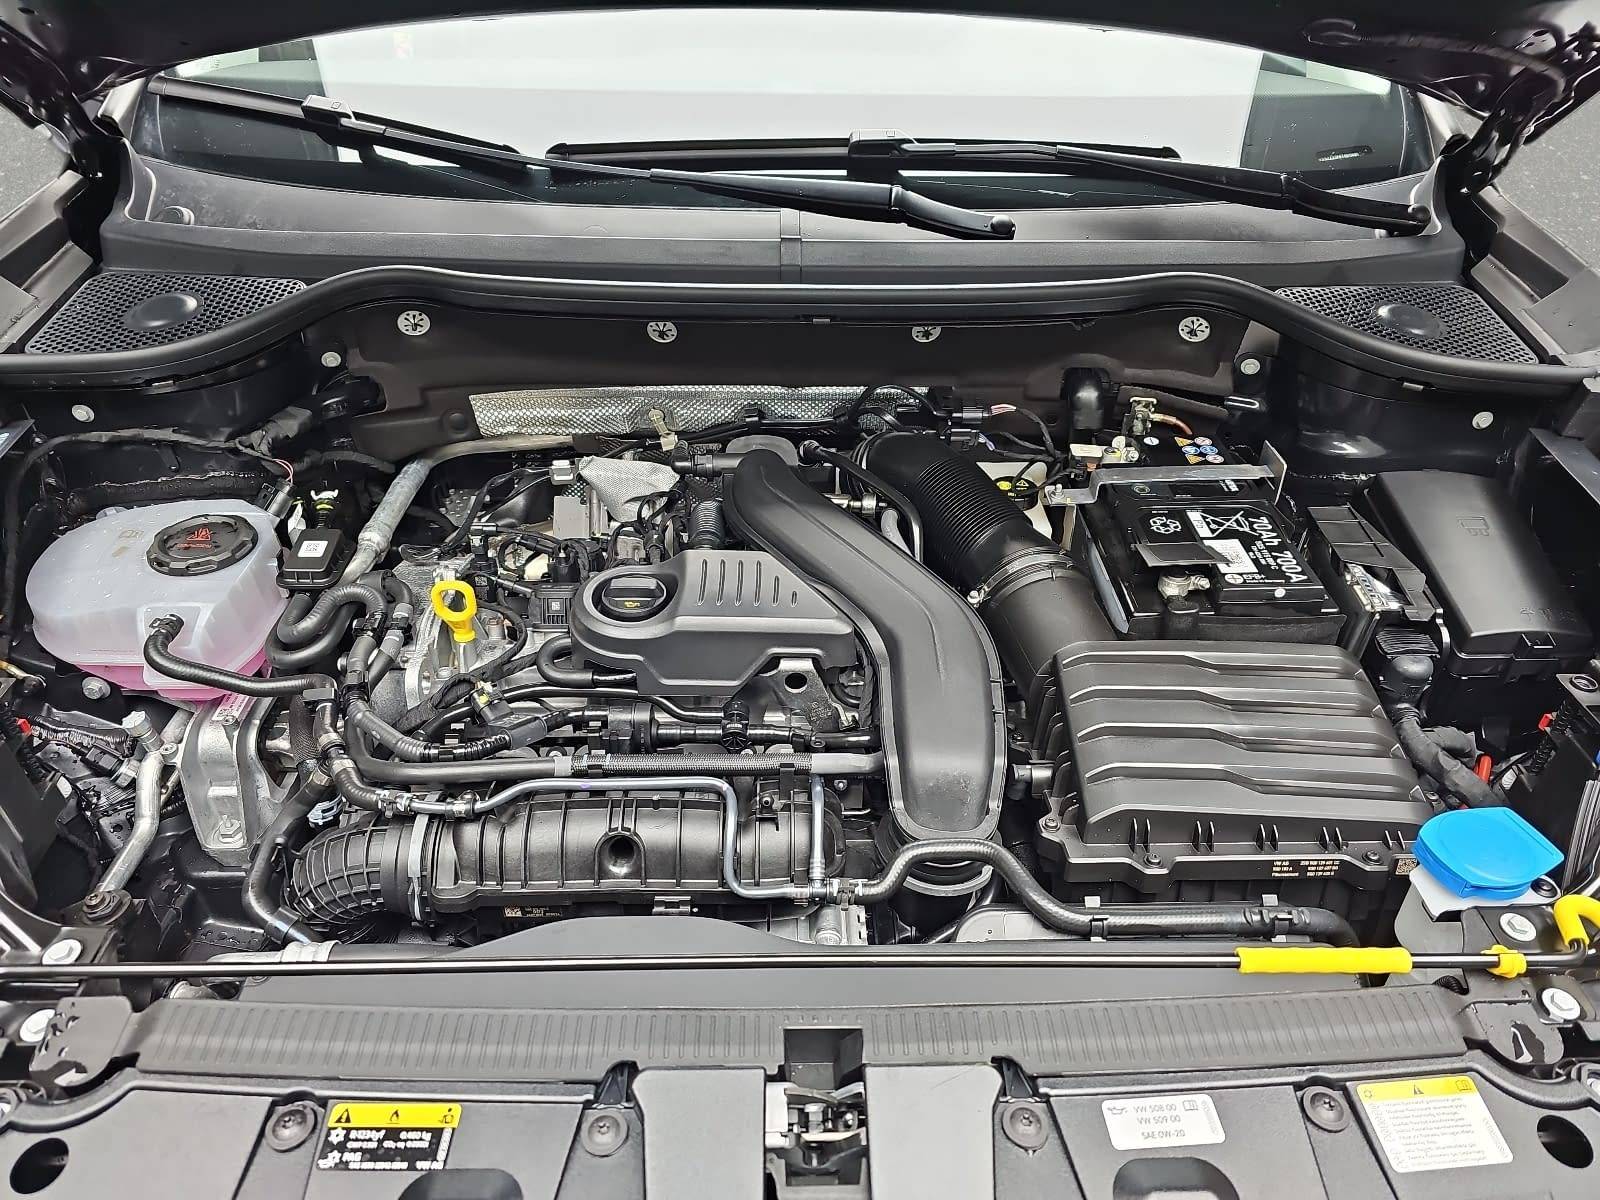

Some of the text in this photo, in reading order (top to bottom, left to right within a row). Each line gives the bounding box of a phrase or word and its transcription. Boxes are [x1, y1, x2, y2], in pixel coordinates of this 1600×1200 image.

[1248, 516, 1282, 547] 70Ah
[1271, 551, 1308, 583] 700A
[1133, 1103, 1177, 1113] VW 508 00
[1136, 1114, 1182, 1125] VW 509 00
[1141, 1130, 1157, 1140] SAE
